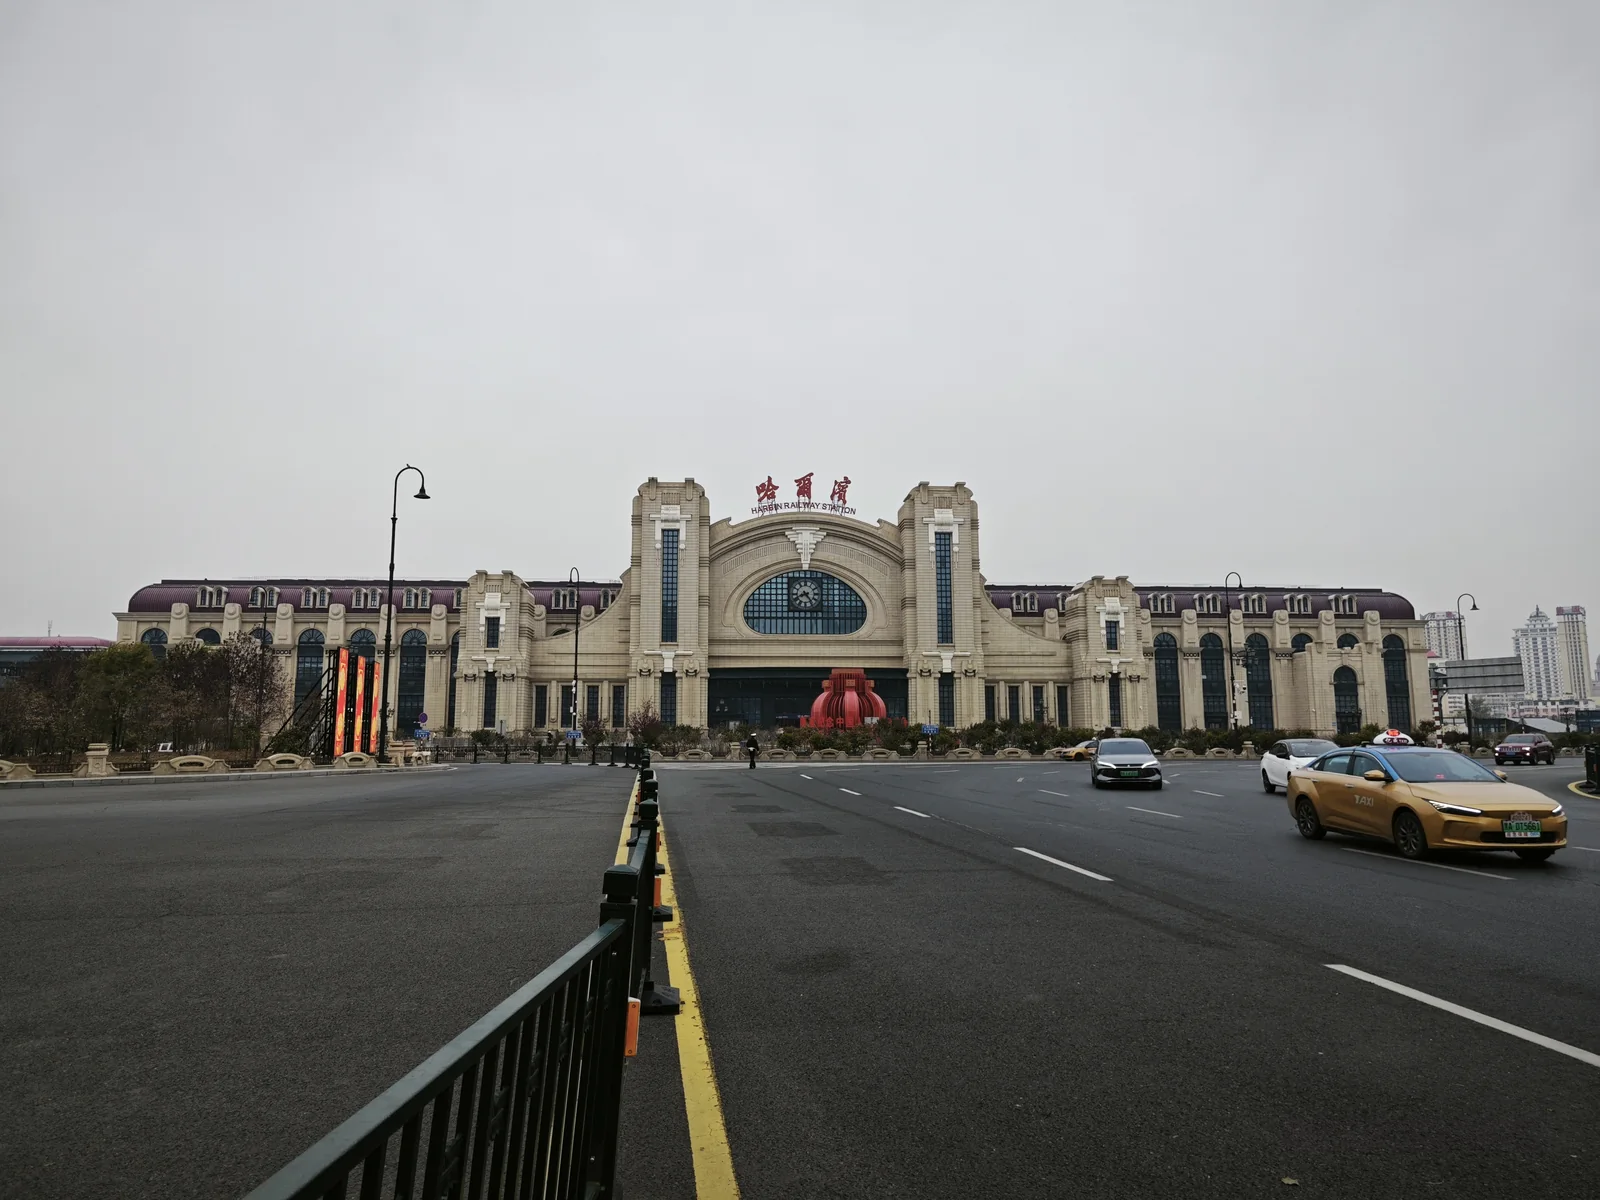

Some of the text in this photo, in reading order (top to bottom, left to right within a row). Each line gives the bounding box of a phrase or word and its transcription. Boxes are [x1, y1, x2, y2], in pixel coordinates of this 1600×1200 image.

[751, 501, 856, 515] HARBIN RAILWAY STATION
[1354, 794, 1374, 808] TAXI
